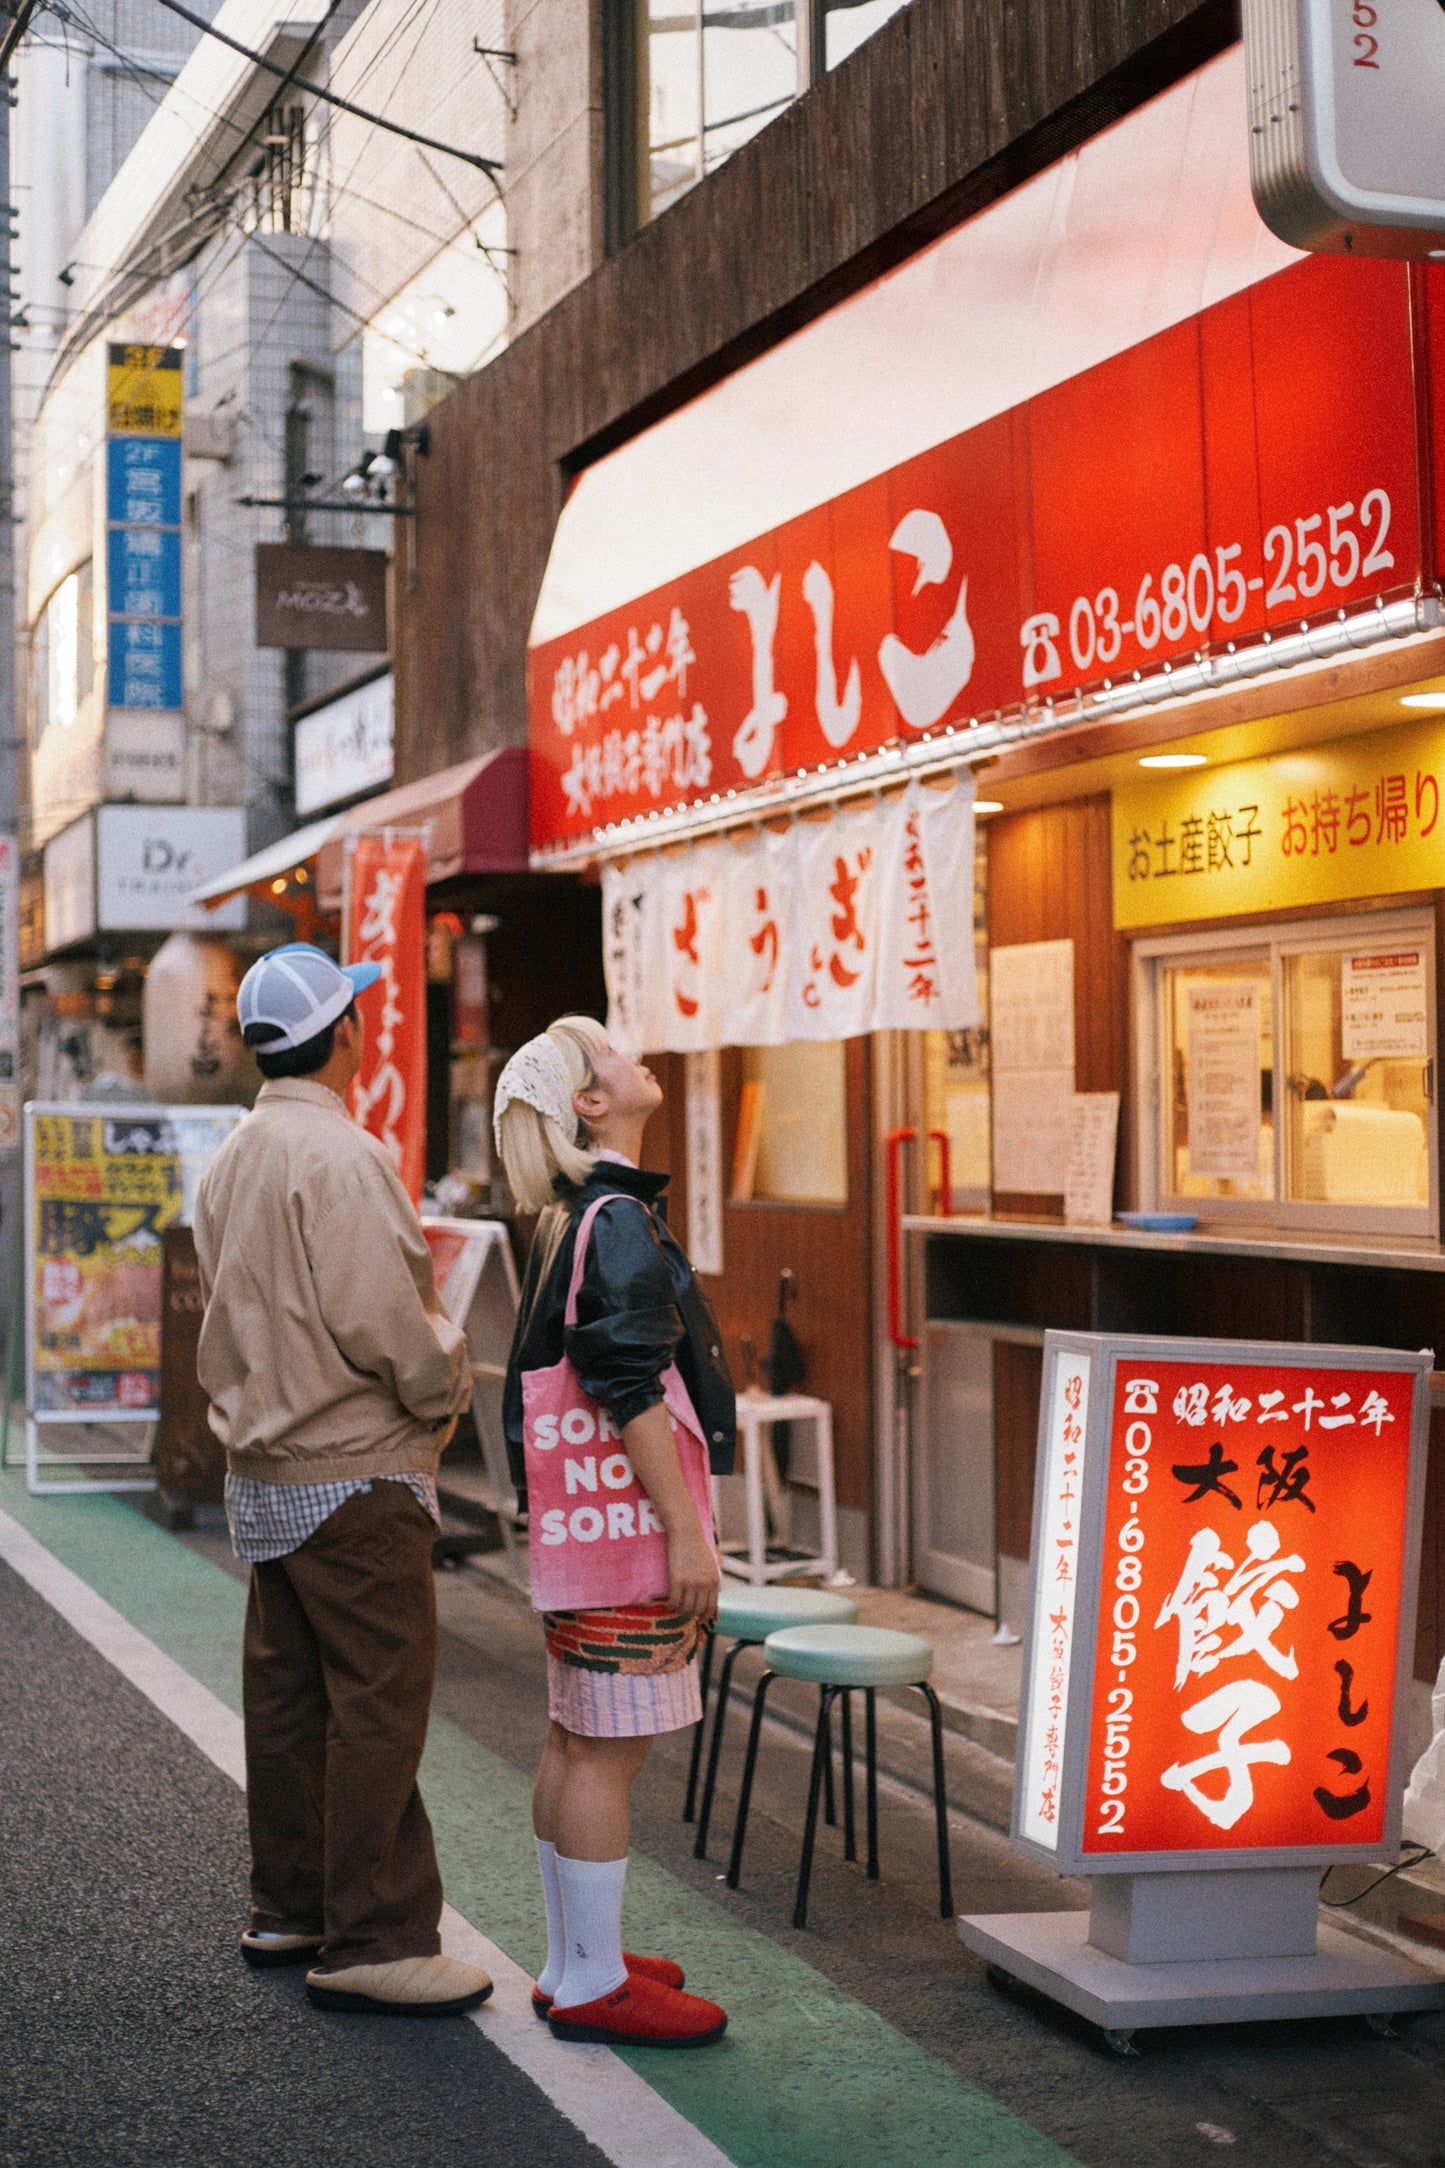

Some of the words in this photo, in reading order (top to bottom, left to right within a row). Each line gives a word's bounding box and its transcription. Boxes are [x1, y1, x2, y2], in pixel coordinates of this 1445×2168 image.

[729, 509, 975, 777] よしこ
[1069, 489, 1394, 670] 03-6805-2552
[552, 607, 696, 735] 昭和二十二年
[1127, 805, 1263, 881] お土産餃子
[1280, 771, 1439, 857] お持ち帰り
[532, 1407, 678, 1450] SOR
[1173, 1382, 1396, 1436] 昭和二十二年
[539, 1499, 667, 1545] SORR
[564, 1453, 634, 1494] NO
[1055, 1375, 1083, 1592] 昭和二十二年
[1172, 1442, 1317, 1513] 大阪
[1098, 1421, 1153, 1834] 03-6805-2552
[1154, 1520, 1306, 1829] 餃子
[1313, 1560, 1374, 1820] よしこ
[1038, 1604, 1069, 1823] 大阪餃子専門店
